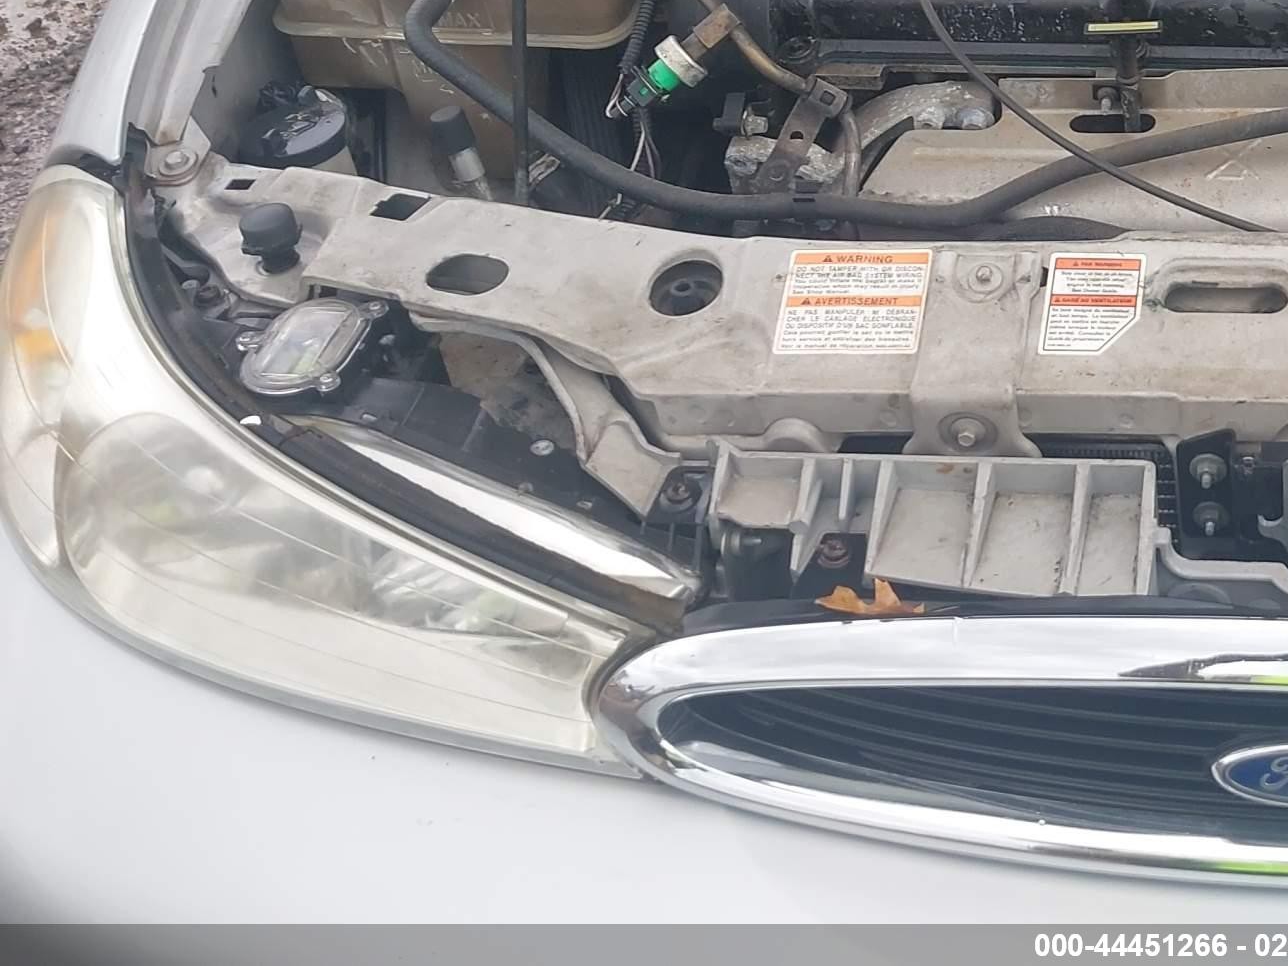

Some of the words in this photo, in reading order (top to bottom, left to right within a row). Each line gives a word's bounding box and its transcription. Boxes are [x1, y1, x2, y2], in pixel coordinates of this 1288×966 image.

[837, 255, 894, 264] WARNING
[829, 265, 857, 273] TAMPER
[815, 297, 898, 306] AVERTISSEMENT
